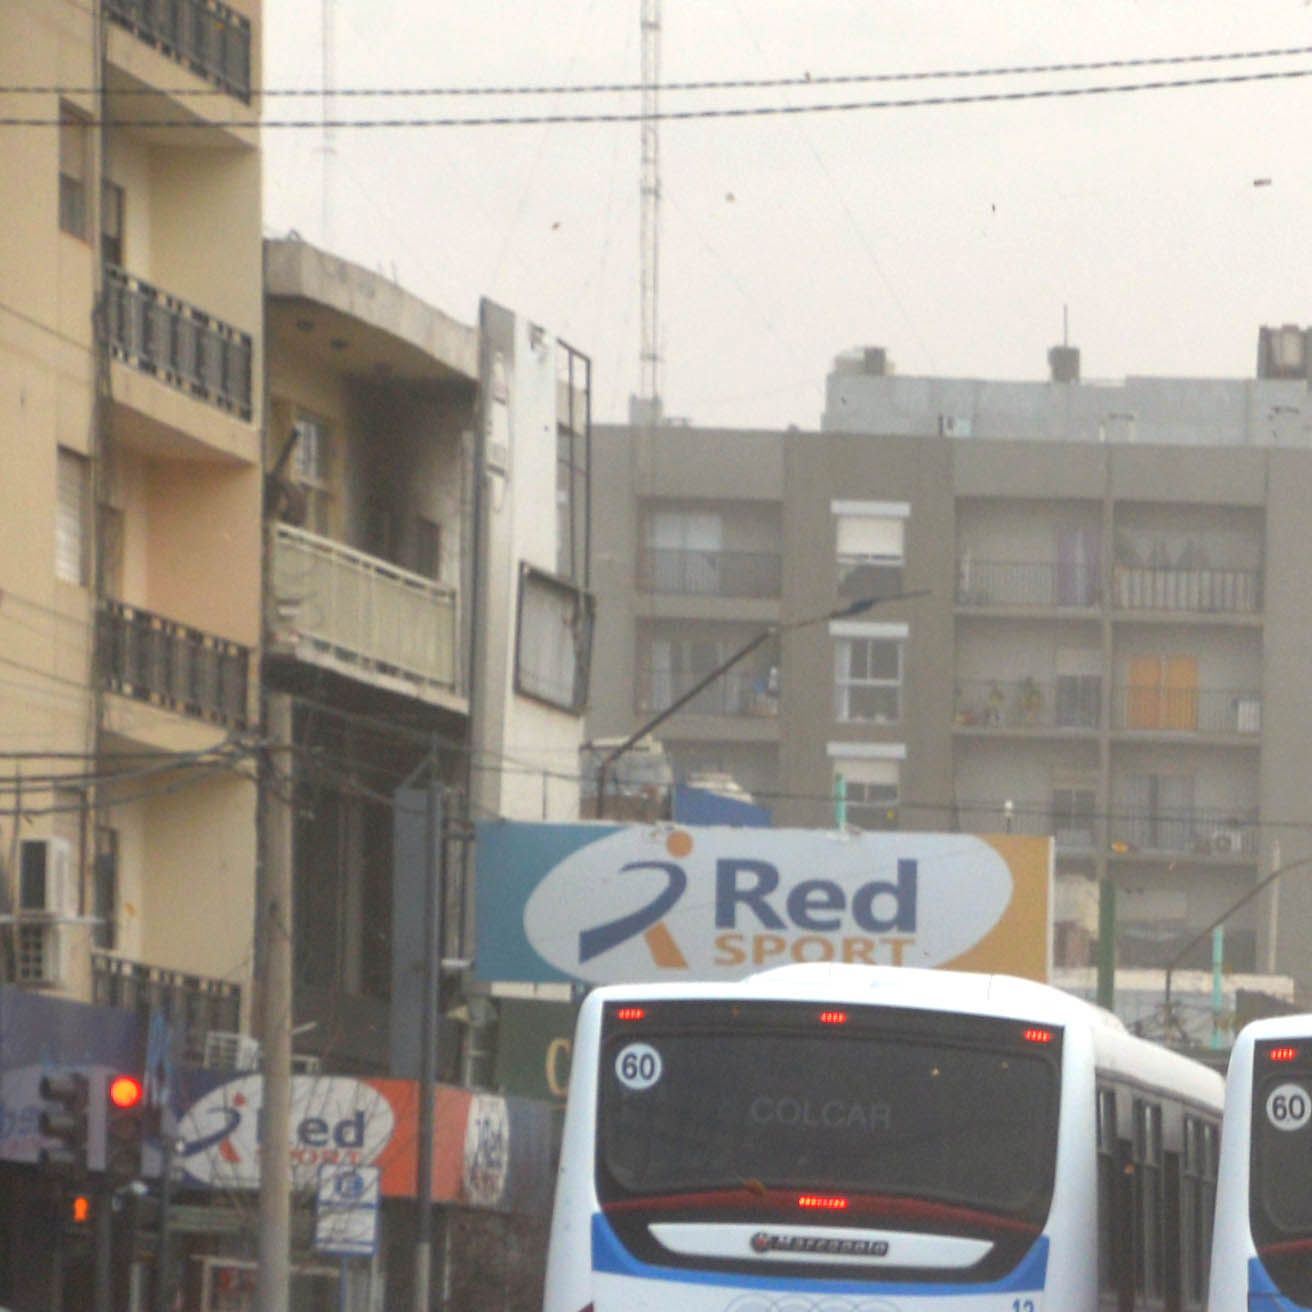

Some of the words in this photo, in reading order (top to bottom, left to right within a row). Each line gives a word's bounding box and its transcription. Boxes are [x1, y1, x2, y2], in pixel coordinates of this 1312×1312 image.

[714, 858, 919, 933] Red
[713, 934, 917, 966] SPORT
[621, 1053, 655, 1081] 60
[750, 1098, 891, 1129] COLCAR
[1271, 1094, 1306, 1121] 60
